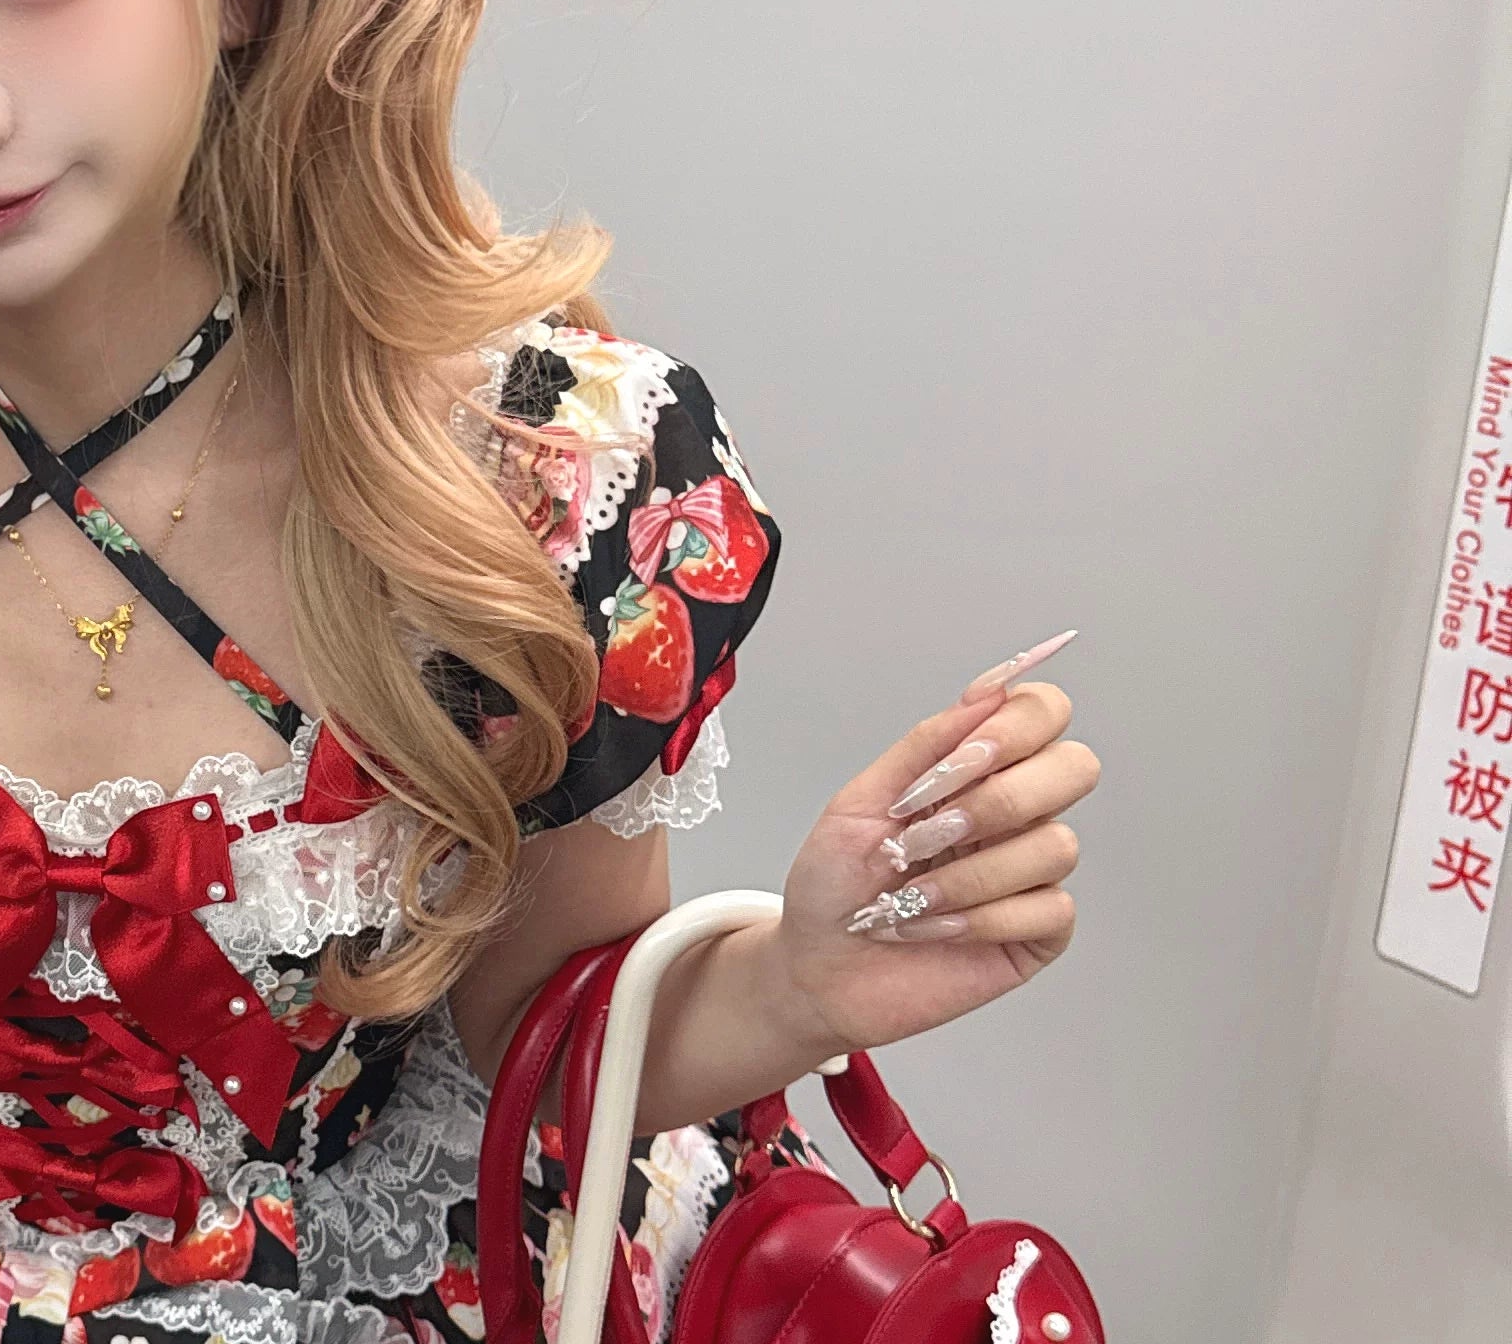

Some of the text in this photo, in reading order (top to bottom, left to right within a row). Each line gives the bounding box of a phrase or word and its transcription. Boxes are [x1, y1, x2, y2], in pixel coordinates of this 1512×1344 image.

[1477, 355, 1512, 439] Mind
[1463, 448, 1501, 524] Your
[1439, 529, 1484, 650] Clothes
